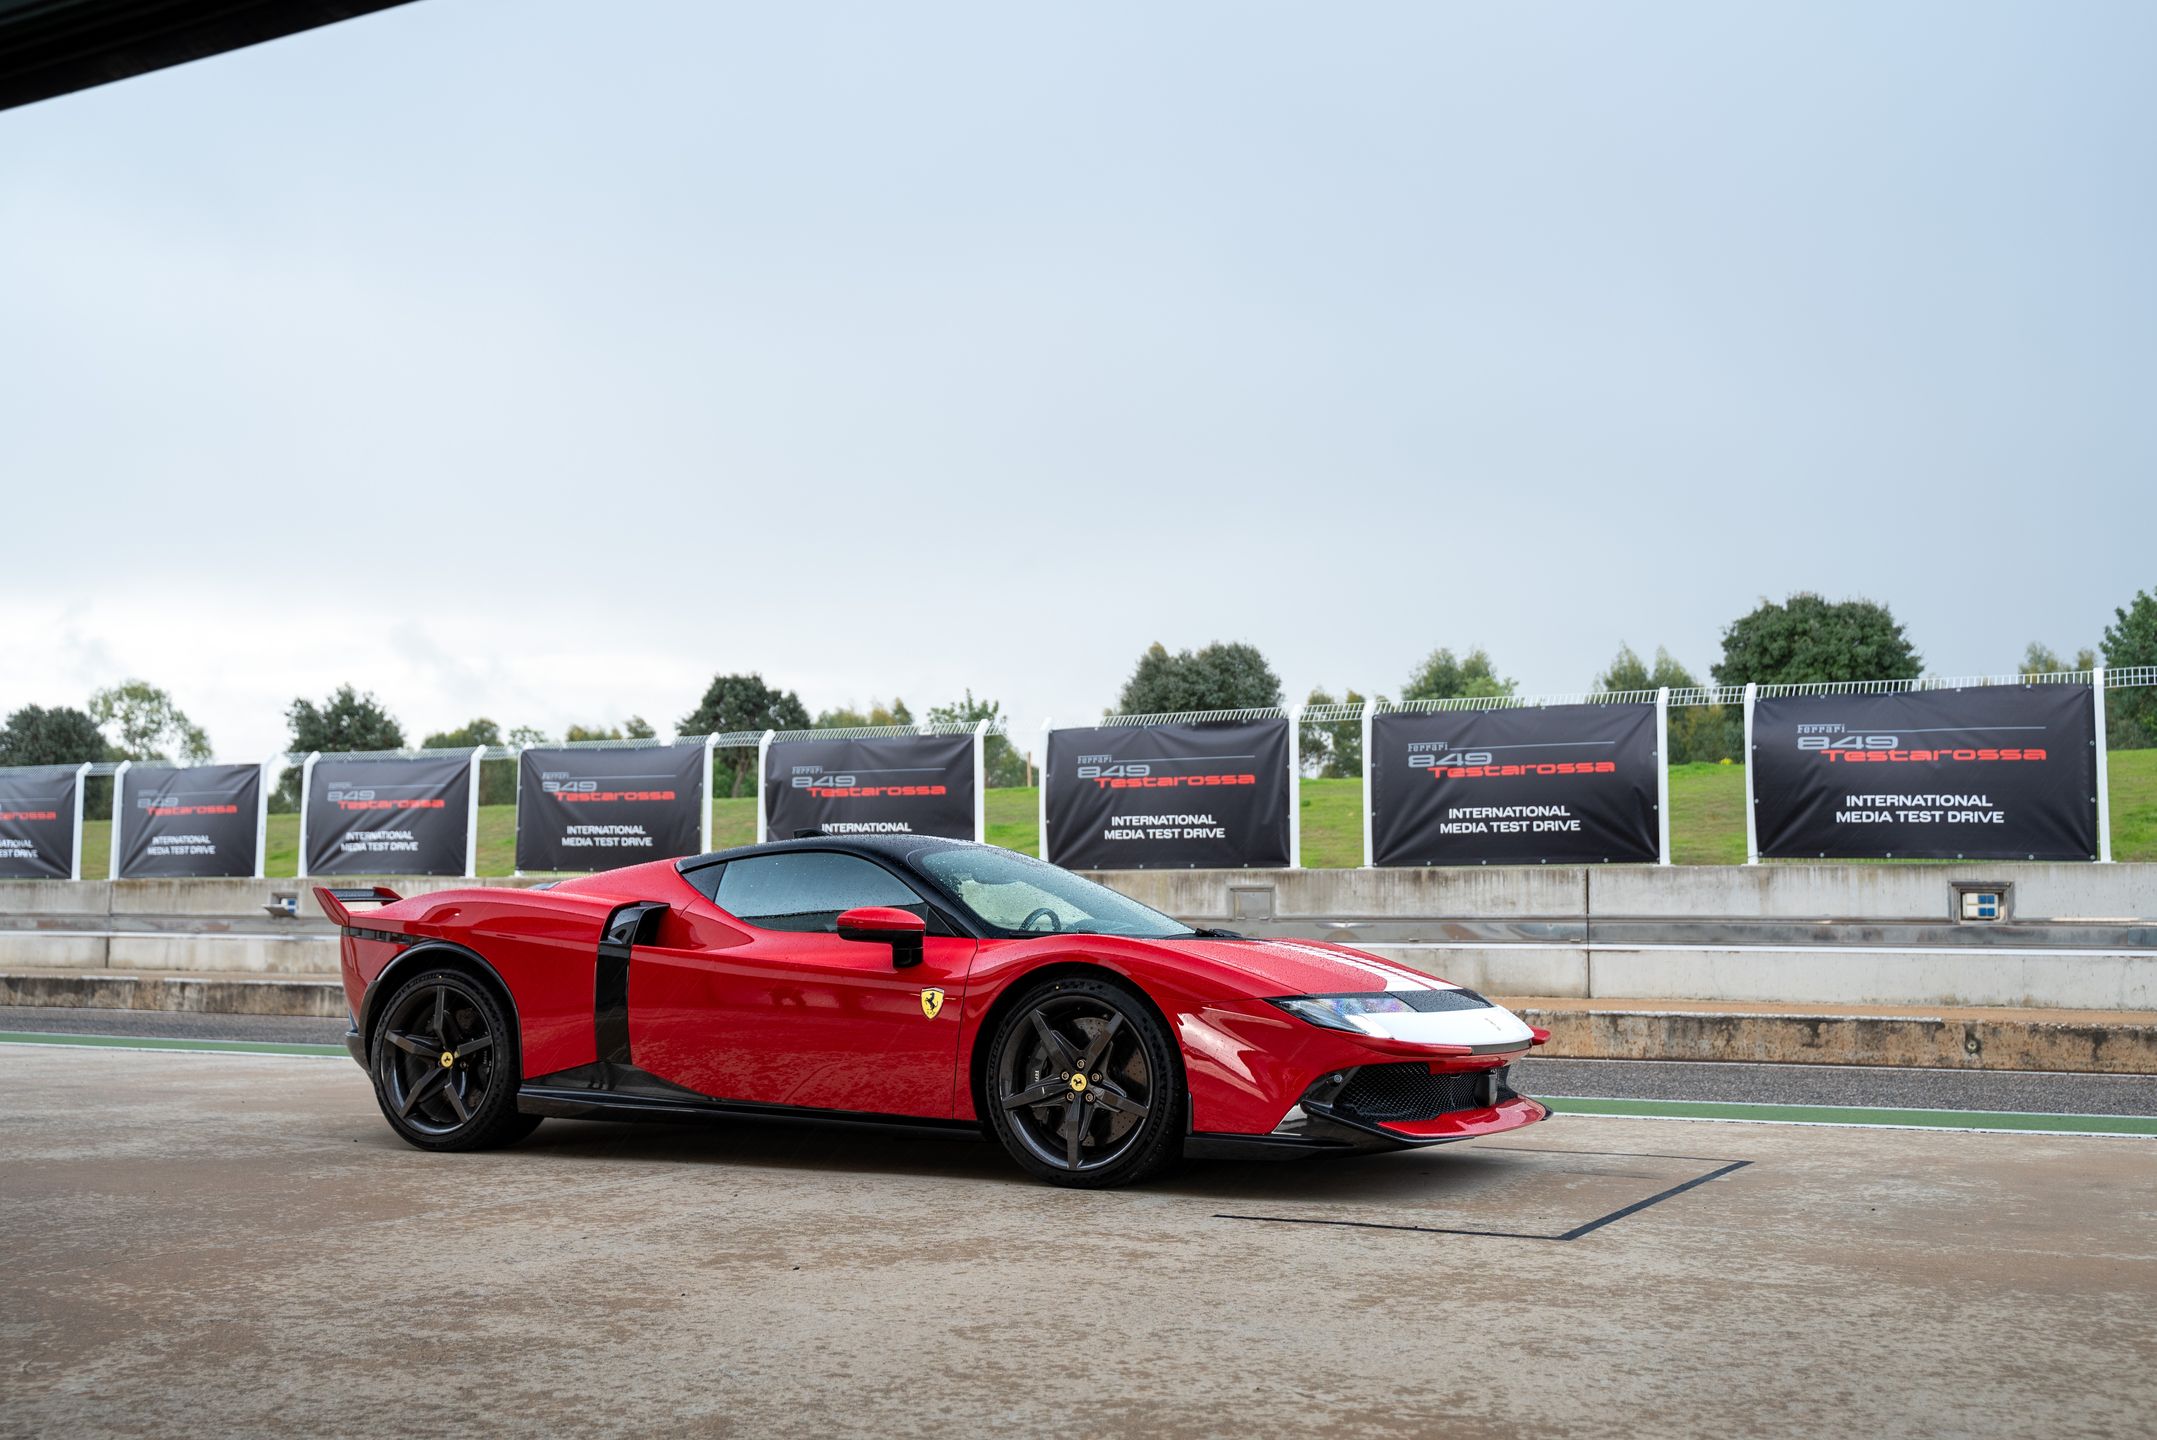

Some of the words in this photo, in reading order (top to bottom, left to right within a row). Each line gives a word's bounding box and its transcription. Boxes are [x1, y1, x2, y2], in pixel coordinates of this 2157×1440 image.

[1797, 723, 1846, 734] Ferrari
[1407, 741, 1448, 752] Ferrari
[1797, 736, 1899, 750] 849
[1408, 752, 1492, 768] 849
[1820, 748, 2047, 763] Testarossa
[1077, 764, 1150, 779] 849
[1427, 761, 1615, 779] Testarossa
[542, 781, 597, 792] 849
[792, 775, 856, 788] 849
[1093, 774, 1256, 789] Testarossa
[327, 790, 375, 801] 849
[553, 791, 676, 801] Testarossa
[806, 785, 947, 798] Testarossa
[338, 799, 445, 810] Testarossa
[1846, 794, 1993, 807] INTERNATIONAL
[1449, 805, 1571, 819] INTERNATIONAL
[1836, 811, 1893, 823] MEDIA
[1895, 810, 1944, 823] TEST
[1947, 810, 2005, 823] DRIVE
[1111, 814, 1216, 826] INTERNATIONAL
[567, 825, 646, 835] INTERNATIONAL
[822, 822, 912, 833] INTERNATIONAL
[1440, 822, 1488, 834] MEDIA
[1490, 821, 1531, 833] TEST
[1533, 820, 1581, 832] DRIVE
[345, 831, 414, 841] INTERNATIONAL
[1104, 829, 1145, 840] MEDIA
[1147, 828, 1181, 839] TEST
[1184, 828, 1225, 839] DRIVE
[152, 835, 211, 845] INTERNATIONAL
[562, 837, 592, 847] MEDIA
[593, 837, 620, 847] TEST
[621, 837, 653, 847] DRIVE
[147, 846, 170, 855] MEDIA
[170, 846, 190, 855] TEST
[190, 845, 216, 854] DRIVE
[340, 842, 367, 851] MEDIA
[367, 842, 389, 851] TEST
[390, 841, 419, 851] DRIVE
[14, 849, 38, 858] DRIVE
